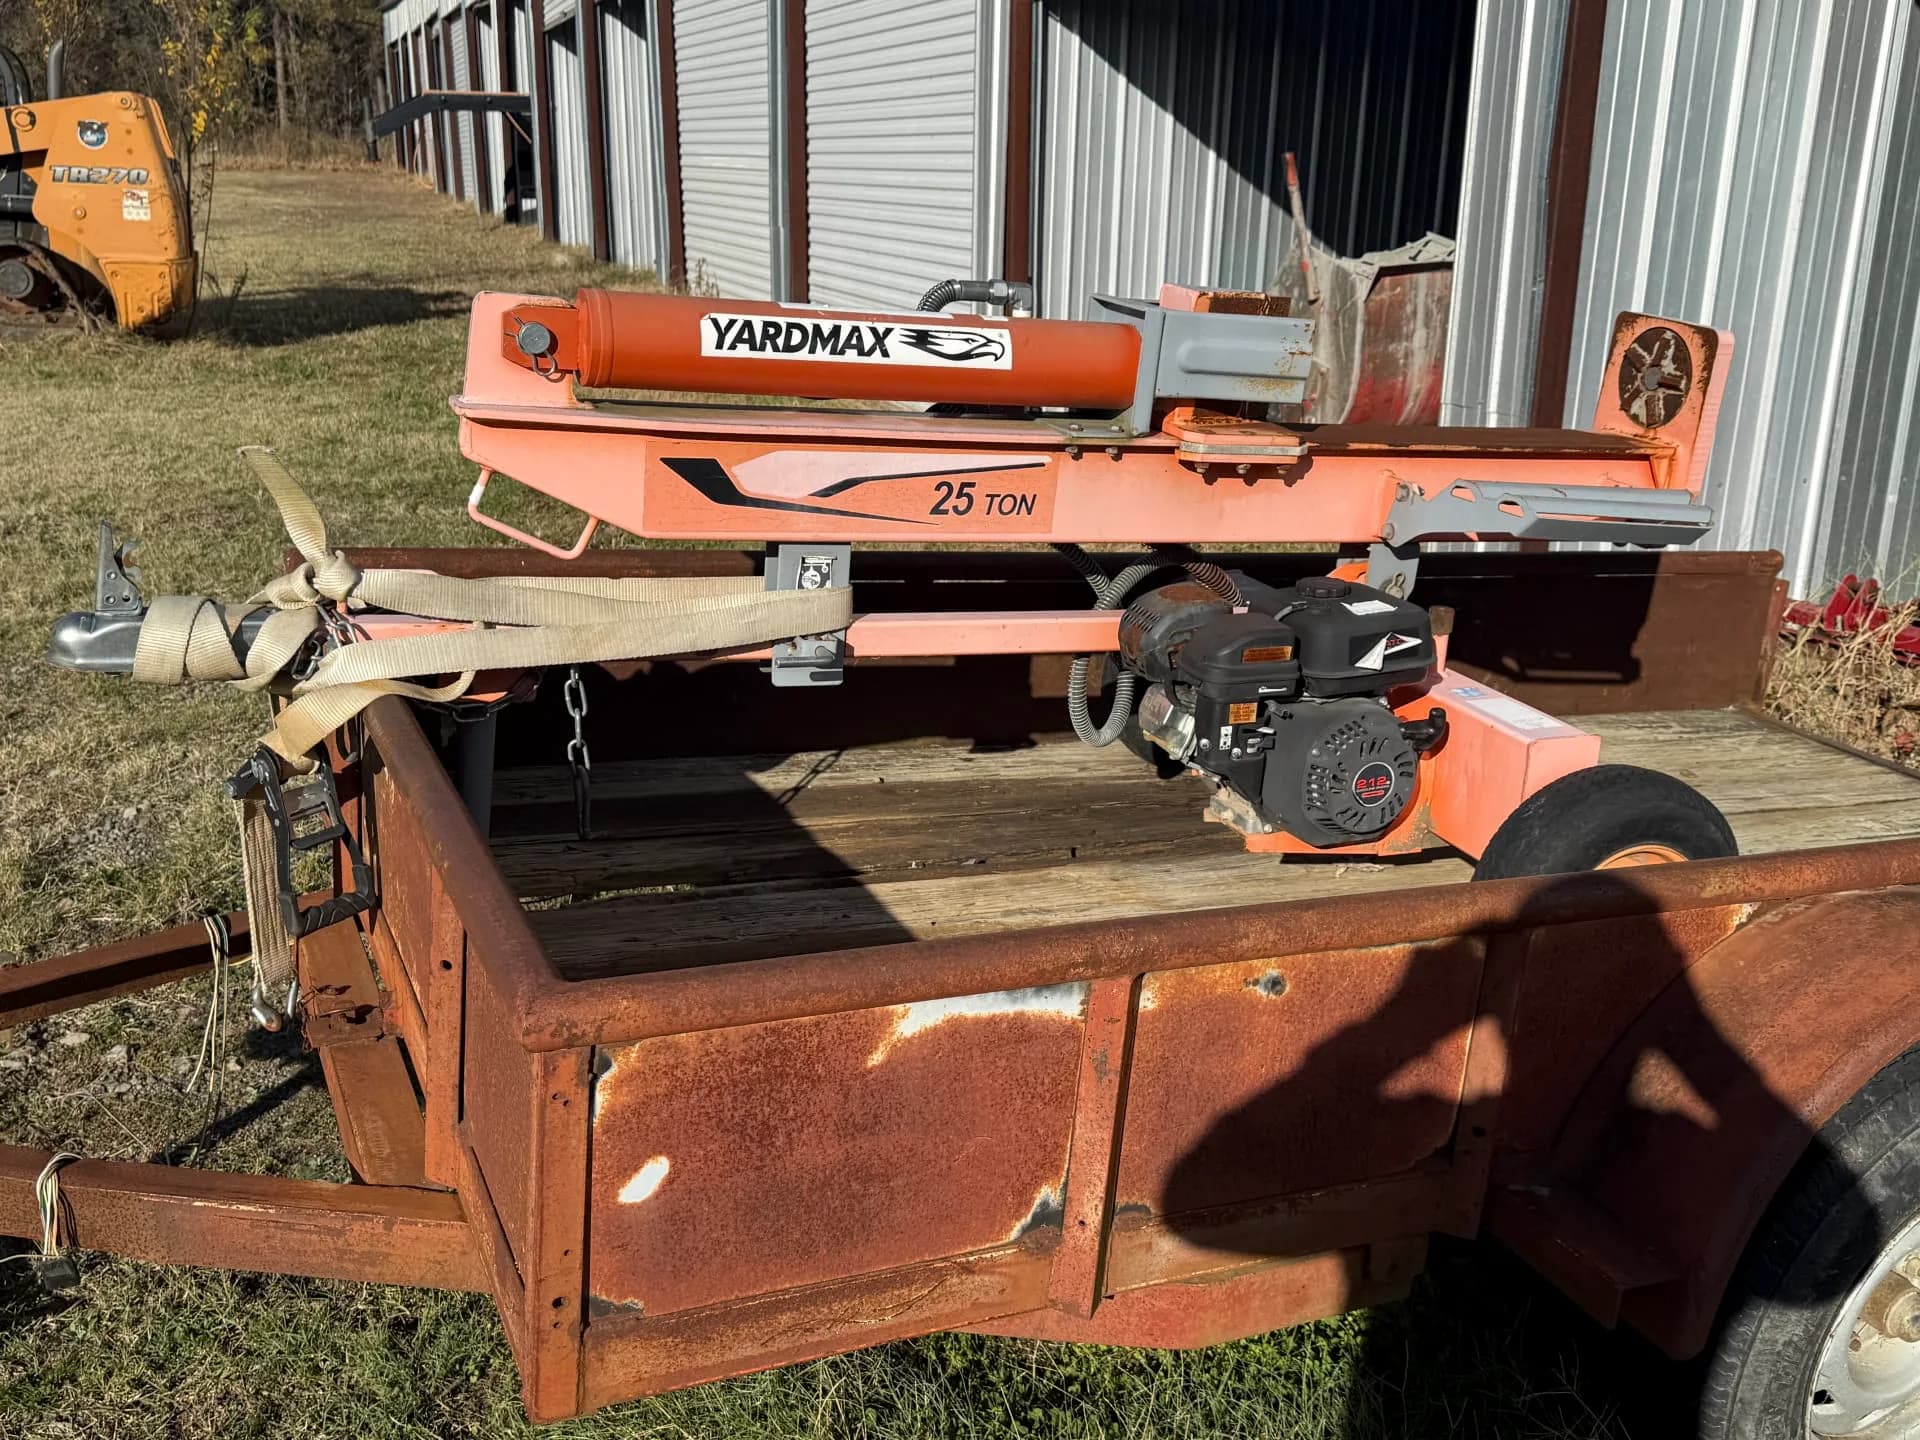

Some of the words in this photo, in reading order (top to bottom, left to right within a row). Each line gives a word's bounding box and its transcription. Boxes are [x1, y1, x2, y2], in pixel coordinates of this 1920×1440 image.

[50, 165, 149, 185] TR270
[709, 318, 895, 358] YARDMAX
[929, 481, 977, 516] 25
[985, 494, 1037, 516] TON
